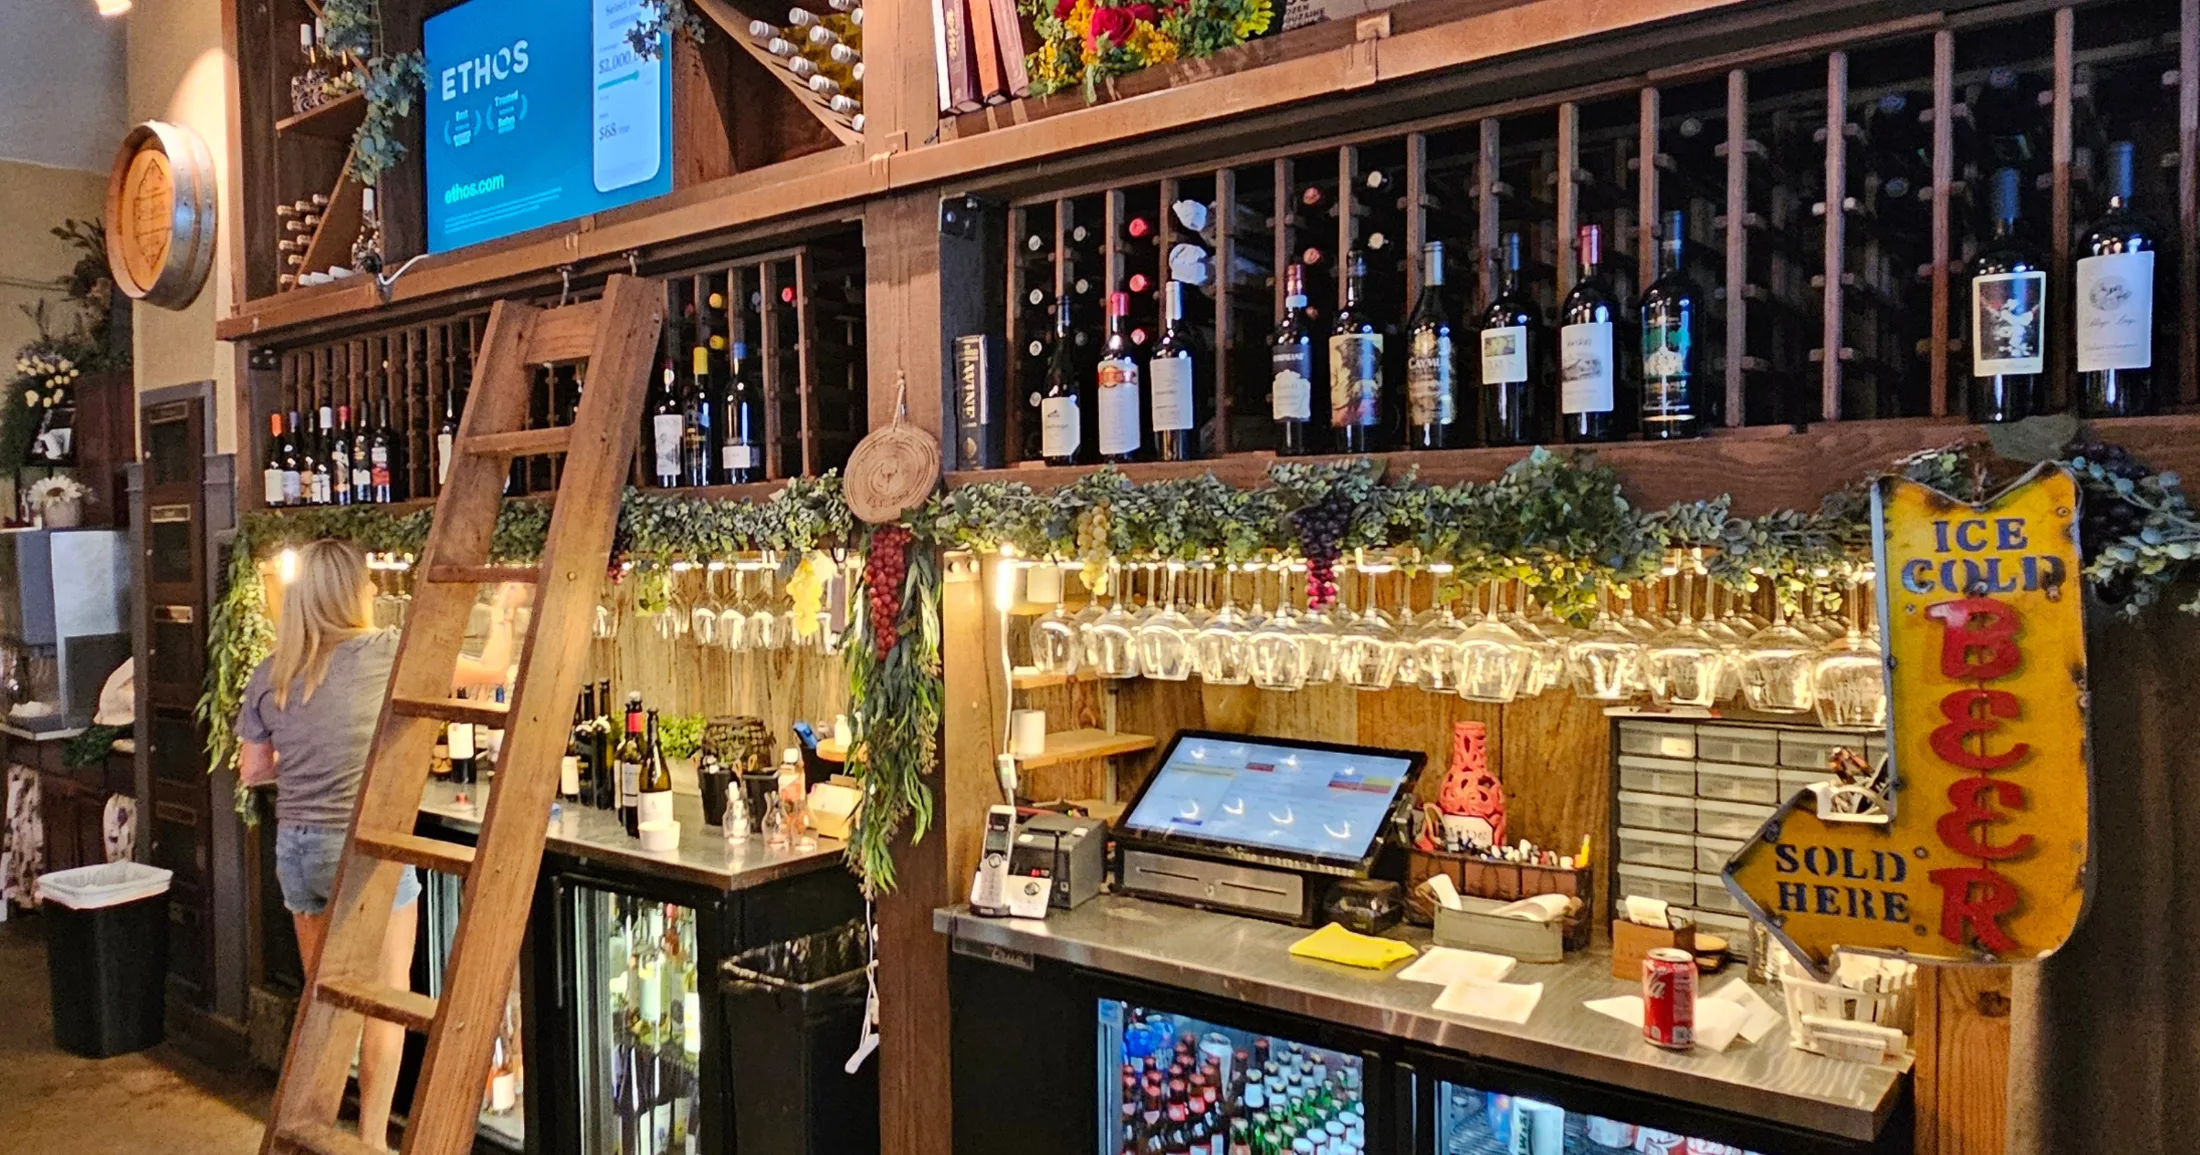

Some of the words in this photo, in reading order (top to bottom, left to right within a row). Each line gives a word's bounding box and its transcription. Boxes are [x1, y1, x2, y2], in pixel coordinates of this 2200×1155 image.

[442, 40, 529, 101] ETHOS
[445, 174, 505, 204] ethos.com
[962, 362, 976, 419] WINE
[1932, 518, 2028, 553] ICE
[1902, 555, 2067, 595] COLD
[1924, 597, 2030, 952] BEER
[1775, 843, 1907, 883] SOLD
[1776, 881, 1911, 924] HERE
